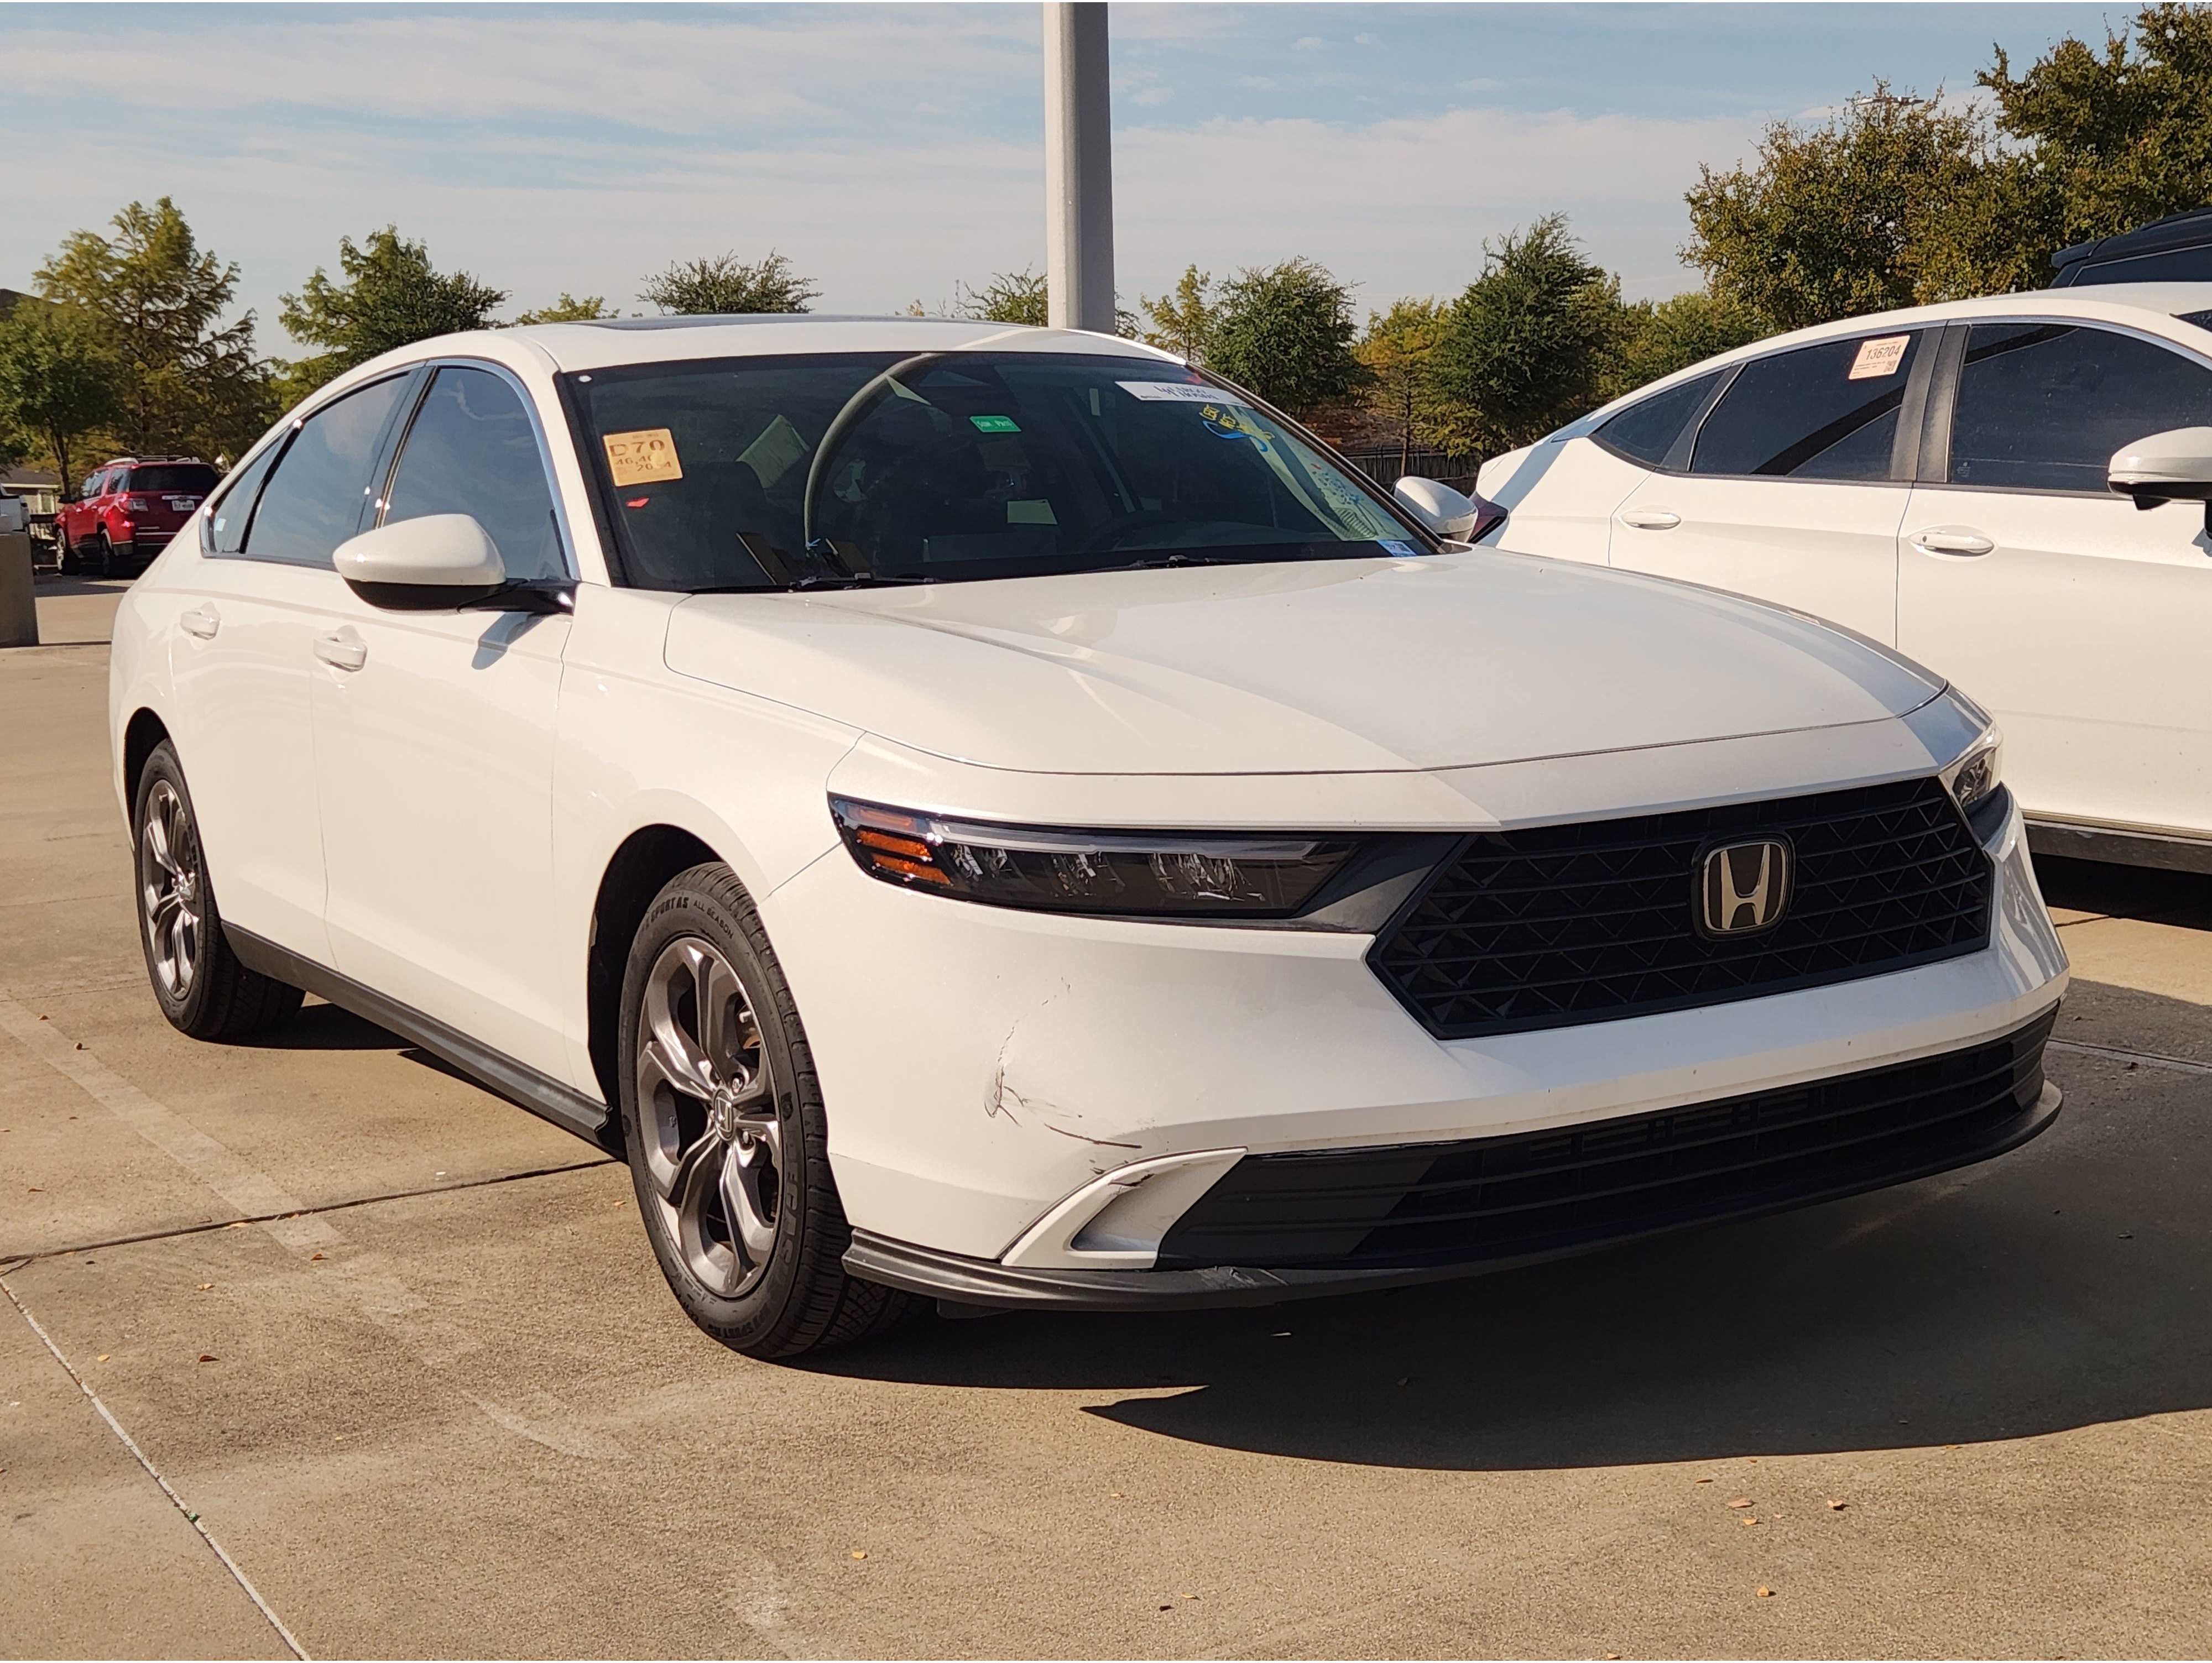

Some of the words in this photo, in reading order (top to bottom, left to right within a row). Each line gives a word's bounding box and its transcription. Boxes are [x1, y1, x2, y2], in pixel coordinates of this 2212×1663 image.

[1866, 345, 1901, 360] 136204
[638, 461, 672, 472] 204
[693, 900, 705, 912] ALL
[707, 908, 734, 939] SEASON
